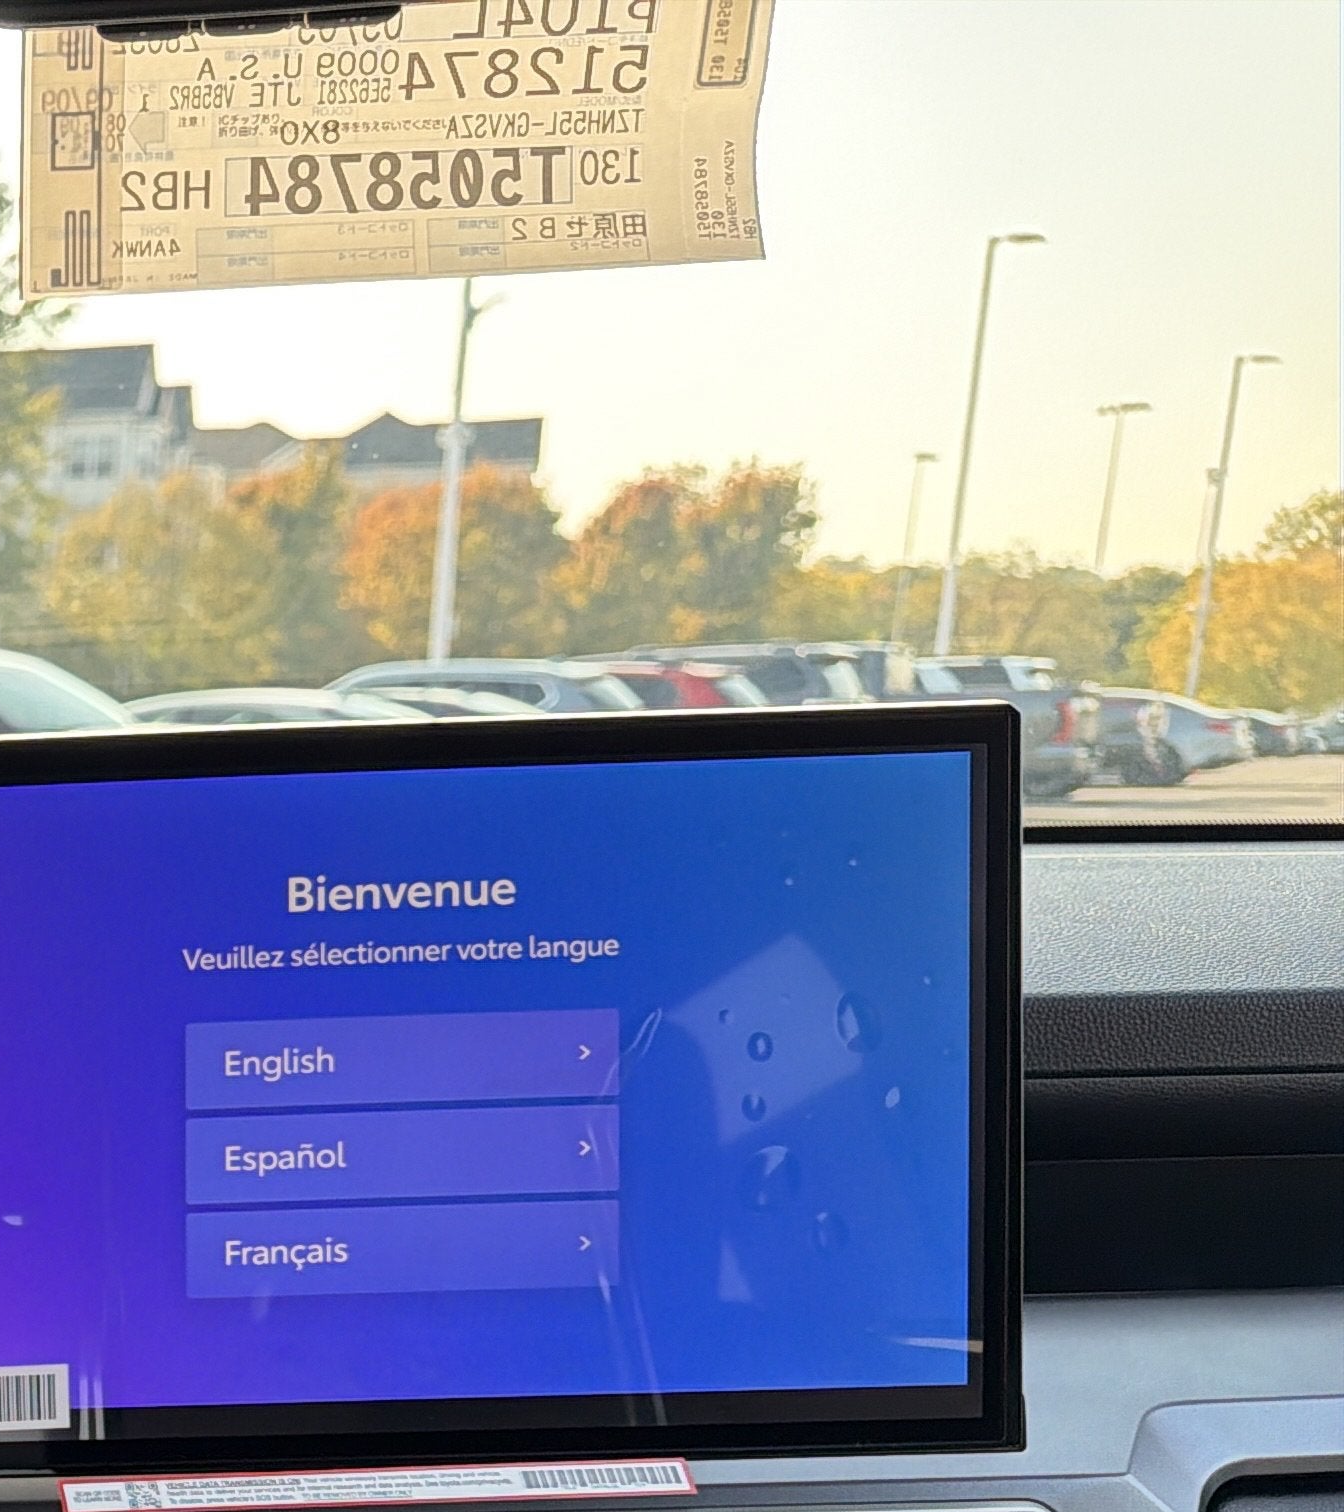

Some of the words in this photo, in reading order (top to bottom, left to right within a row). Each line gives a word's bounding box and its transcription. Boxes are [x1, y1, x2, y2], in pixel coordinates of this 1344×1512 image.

[287, 874, 517, 913] Bienvenue
[182, 944, 285, 971] Veuillez
[290, 940, 452, 968] sélectionner
[455, 938, 523, 961] votre
[528, 934, 620, 963] langue
[224, 1046, 336, 1083] English
[224, 1140, 347, 1177] Español
[224, 1236, 348, 1272] Français
